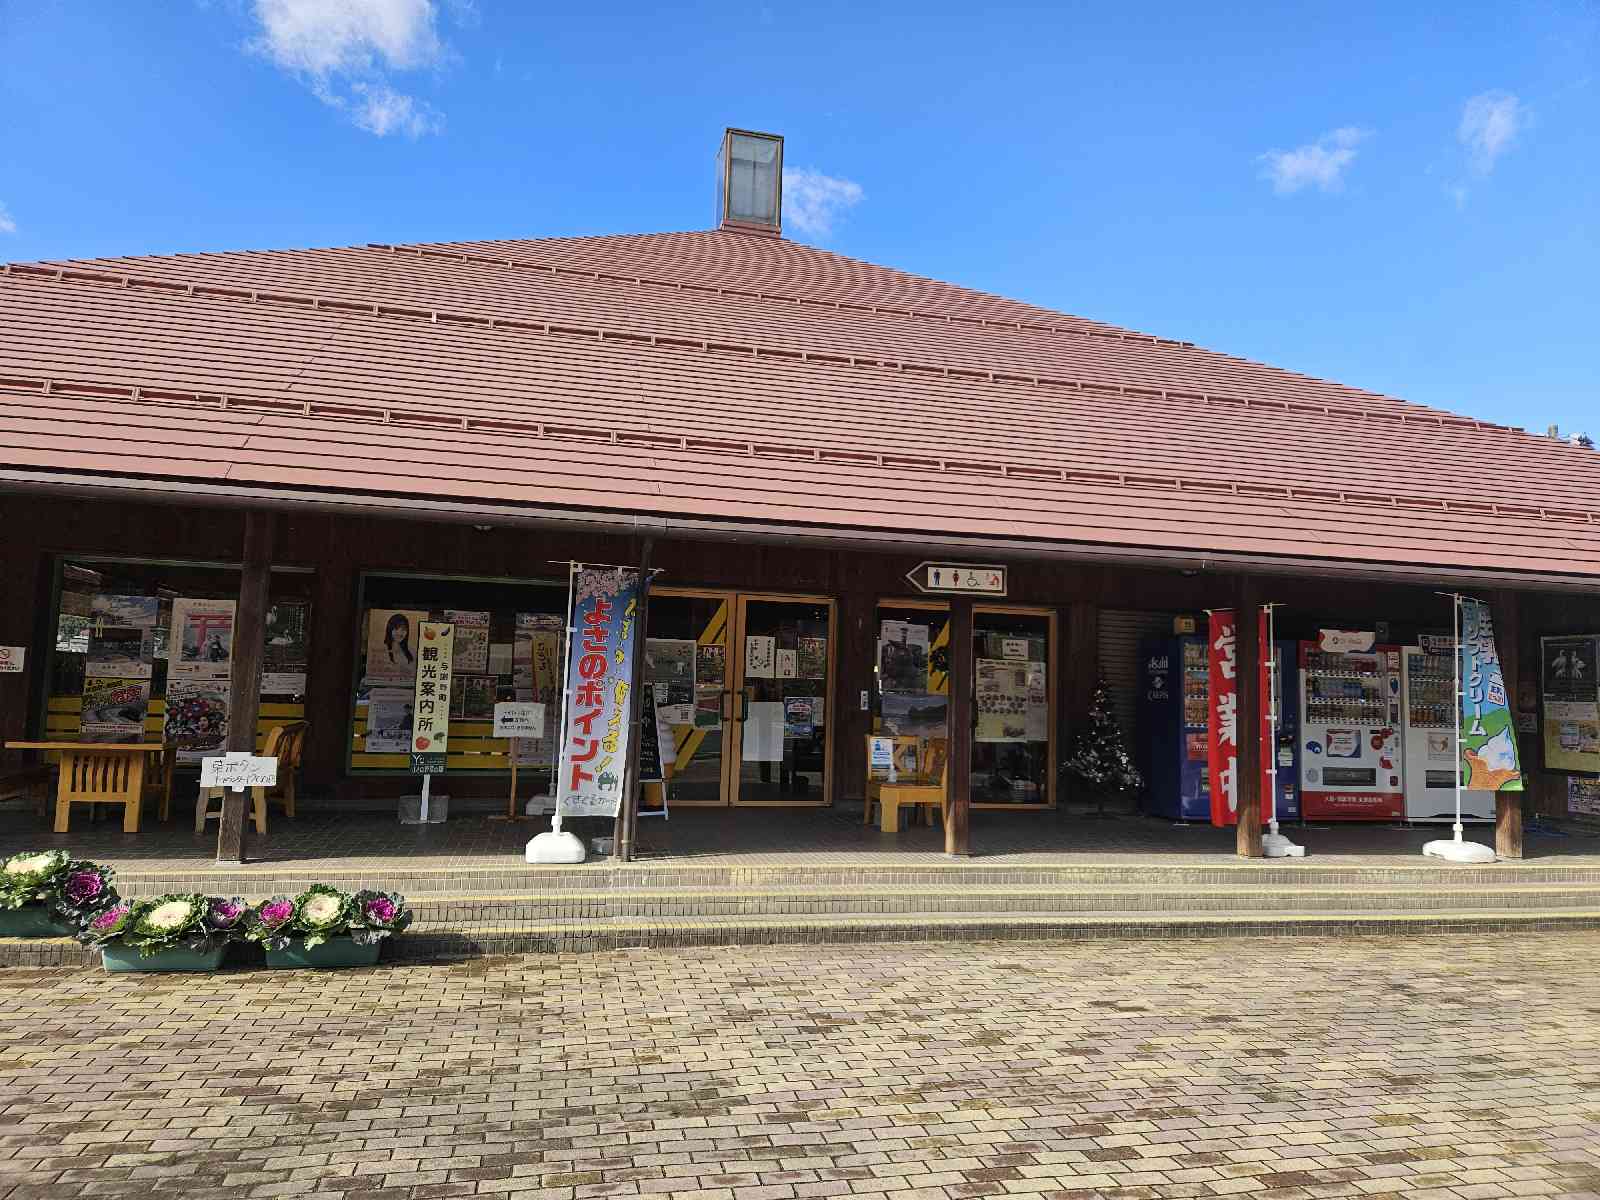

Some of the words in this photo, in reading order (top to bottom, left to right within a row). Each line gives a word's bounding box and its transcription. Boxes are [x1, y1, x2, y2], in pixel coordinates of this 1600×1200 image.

[417, 646, 439, 732] 観光案内所
